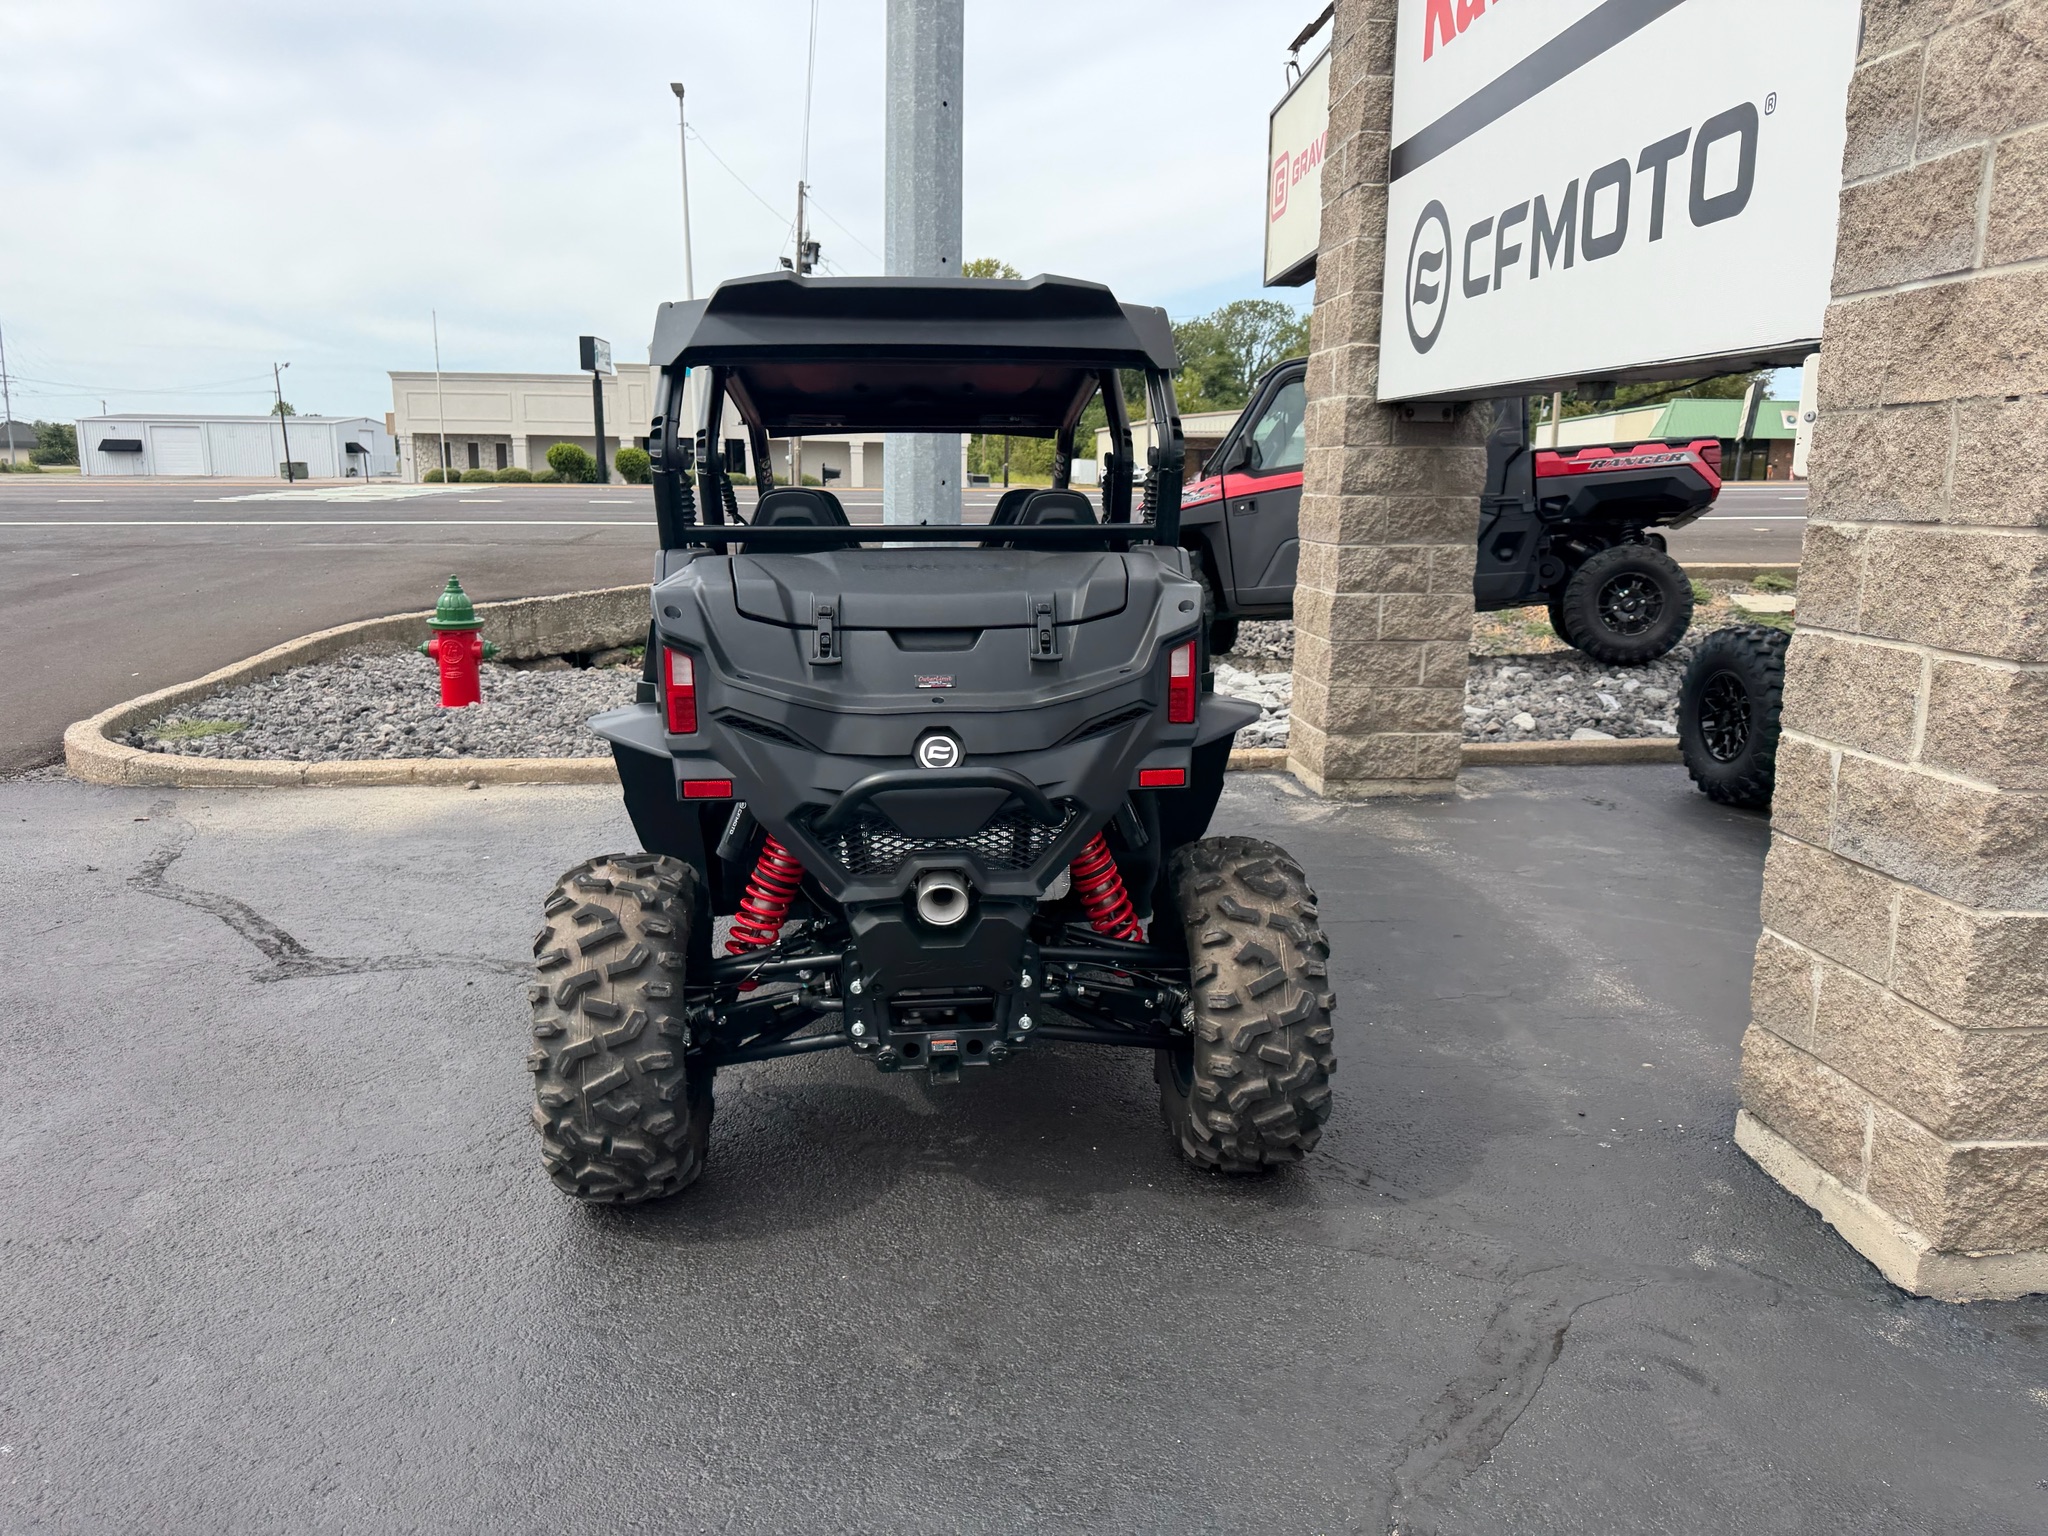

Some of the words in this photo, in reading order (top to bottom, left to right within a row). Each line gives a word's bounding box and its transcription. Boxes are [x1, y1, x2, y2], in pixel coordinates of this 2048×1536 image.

[1292, 130, 1328, 187] GRAV
[1463, 101, 1759, 299] CFMOTO
[1588, 452, 1686, 470] RANGER
[729, 808, 743, 835] CFMOTO
